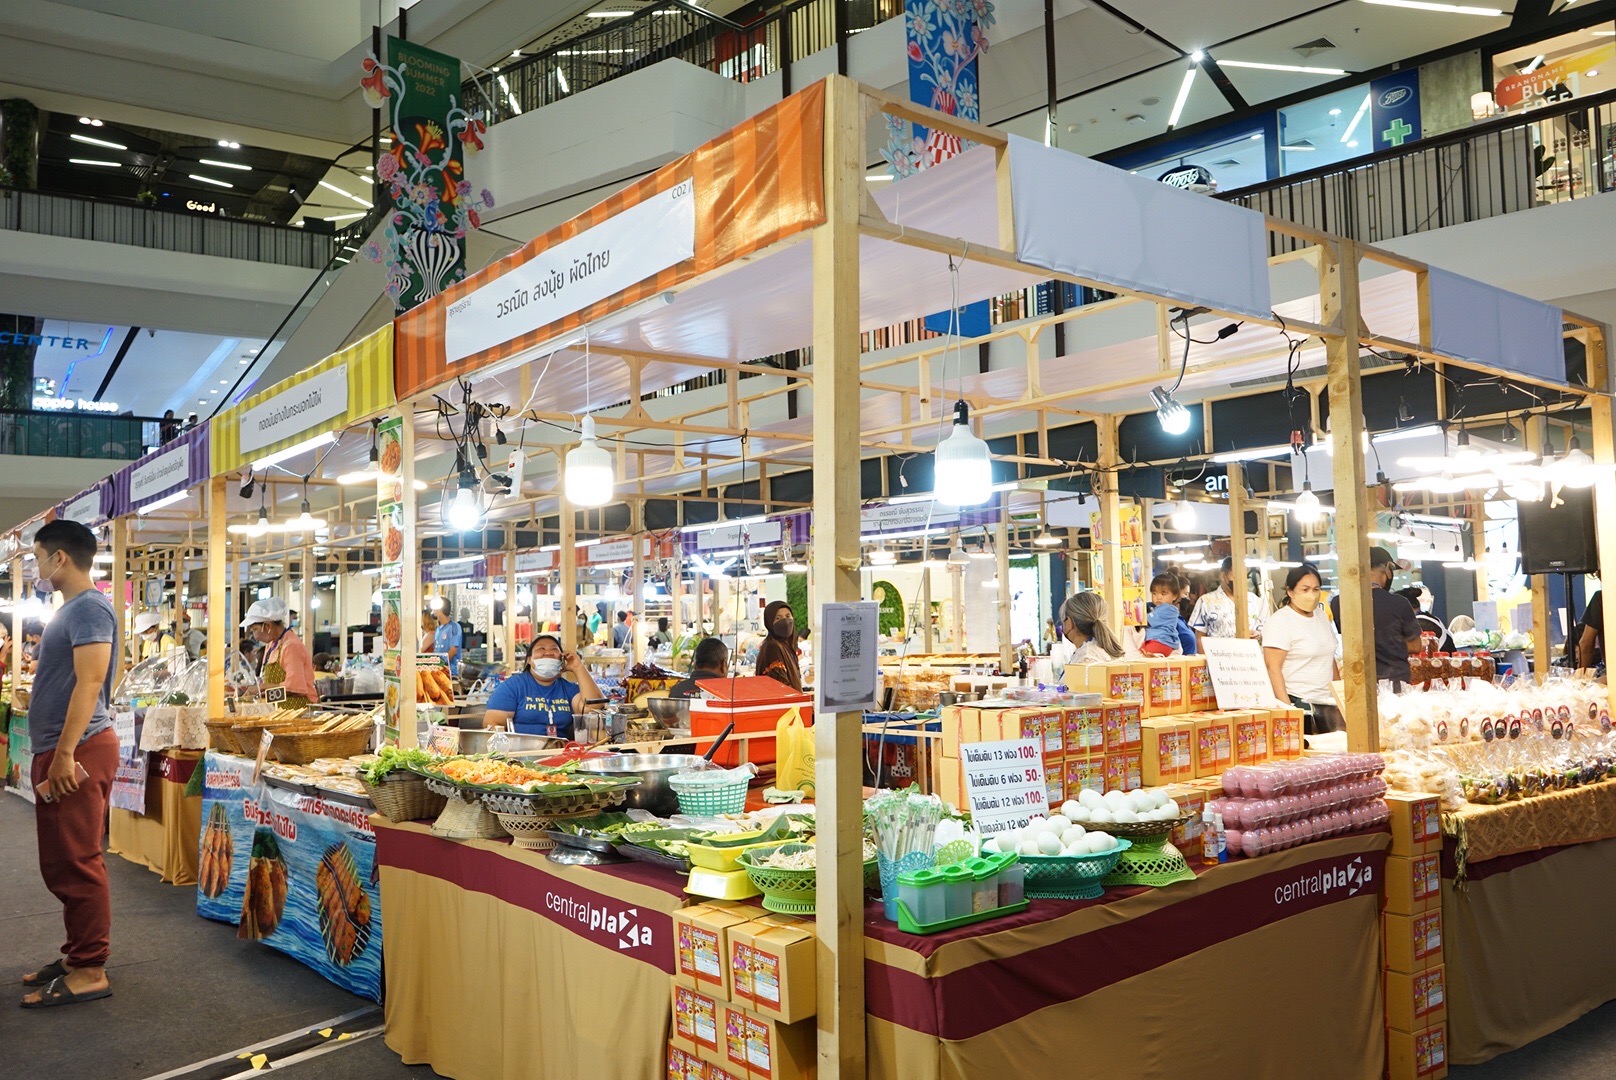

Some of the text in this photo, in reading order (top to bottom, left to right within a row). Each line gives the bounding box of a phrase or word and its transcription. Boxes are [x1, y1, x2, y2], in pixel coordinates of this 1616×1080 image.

[398, 53, 450, 77] BLOOMING
[405, 68, 445, 87] SUMMER
[1505, 66, 1564, 92] BRANDNAME
[1522, 70, 1579, 100] BUY 1
[415, 82, 437, 96] 2022
[496, 288, 529, 319] วรณิต
[569, 249, 610, 284] ผัดไทย
[0, 331, 89, 350] CENTER
[750, 621, 760, 631] 70
[268, 688, 282, 701] 80
[993, 750, 1003, 761] 13
[1003, 750, 1017, 760] ฟอง
[1017, 746, 1038, 759] 100.-
[1000, 775, 1006, 785] 6
[1007, 773, 1022, 784] ฟอง
[1025, 768, 1041, 782] 50.-
[1001, 797, 1011, 808] 12
[1011, 796, 1025, 806] ฟอง
[1024, 790, 1045, 805] 100.-
[1006, 820, 1016, 830] 12
[1016, 818, 1029, 829] ฟอง
[1274, 855, 1373, 905] centralplaza
[545, 891, 653, 949] centralplaza
